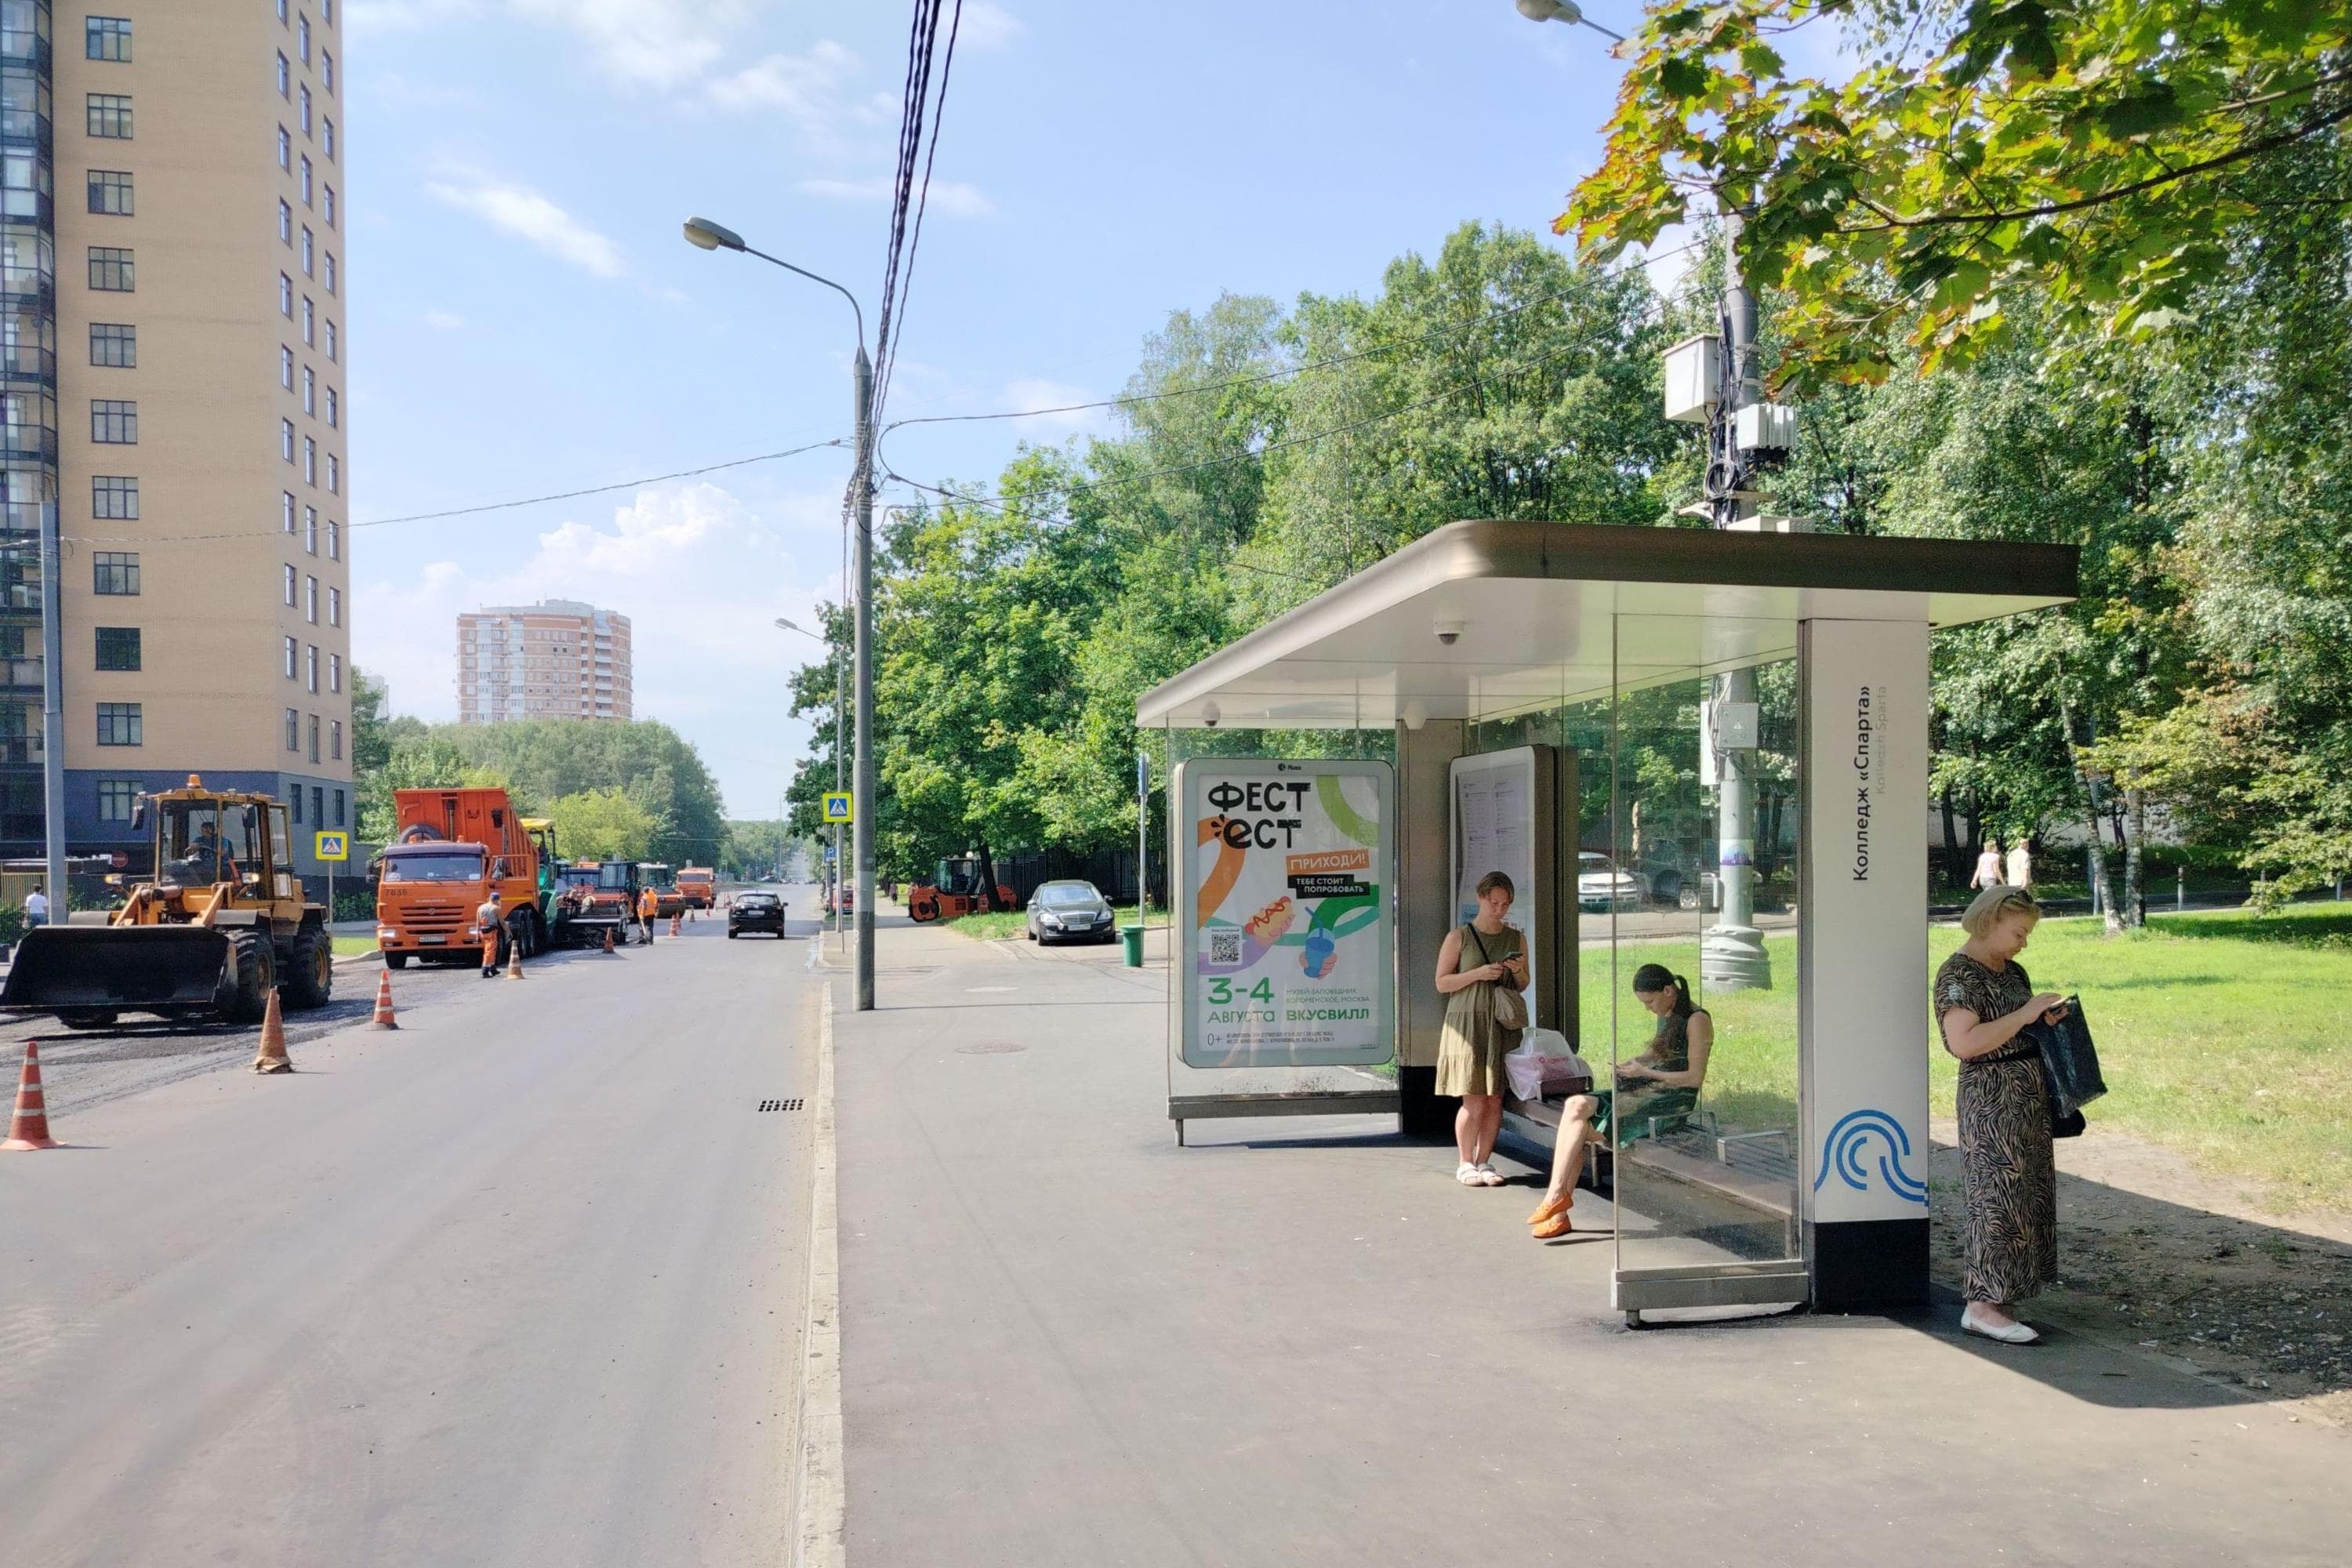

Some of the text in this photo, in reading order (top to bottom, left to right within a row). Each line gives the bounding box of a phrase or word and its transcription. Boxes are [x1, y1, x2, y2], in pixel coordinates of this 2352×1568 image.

[1875, 686, 1888, 731] Sparta
[1208, 782, 1311, 812] ФЕСТ
[1853, 686, 1873, 880] Колледж «Спарта»
[1290, 852, 1366, 870] ПРИХОДИ!
[1207, 977, 1275, 1005] 3-4
[1287, 1008, 1370, 1022] ВКУСВИЛЛ
[1208, 1033, 1221, 1046] 0+
